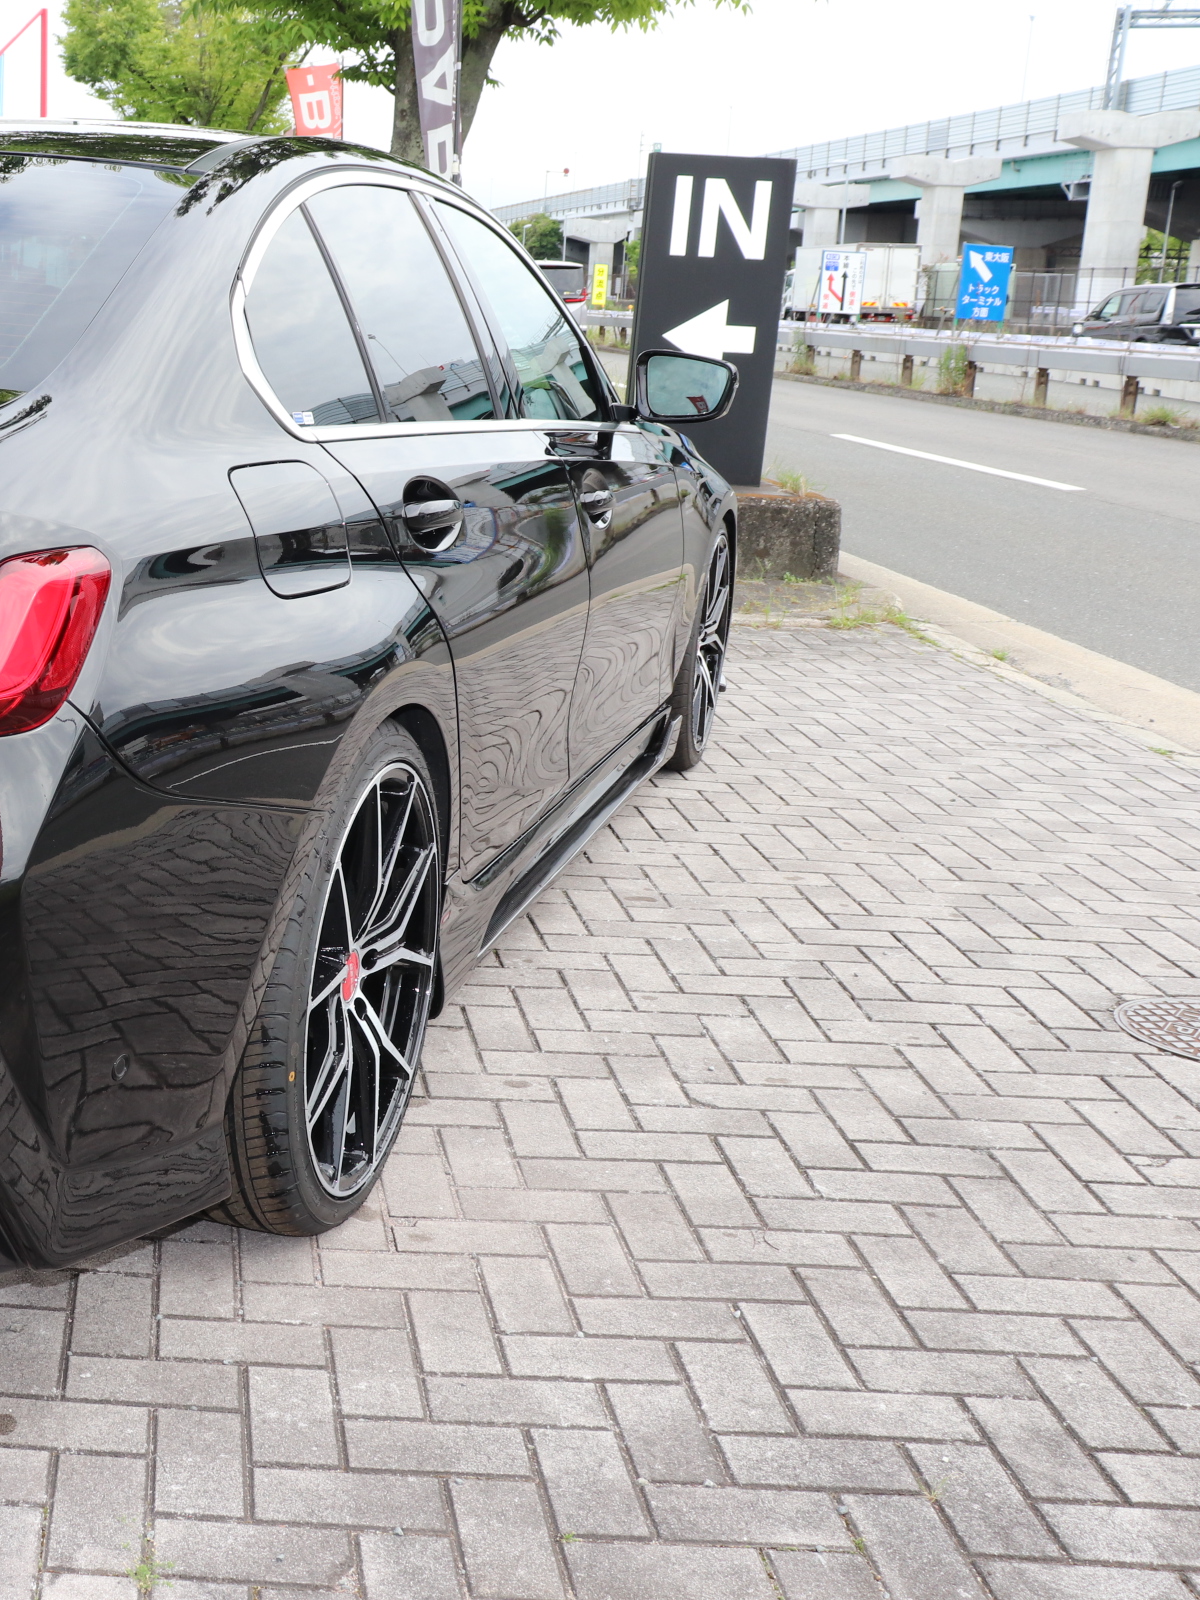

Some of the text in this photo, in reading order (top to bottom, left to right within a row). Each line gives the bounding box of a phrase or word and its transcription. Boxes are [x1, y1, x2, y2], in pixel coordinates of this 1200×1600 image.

[669, 174, 773, 260] IN
[985, 251, 1010, 263] 東大阪
[596, 267, 604, 300] 分流点
[968, 283, 1000, 295] トラック
[961, 295, 1002, 306] ターミナル
[972, 307, 989, 318] 方面
